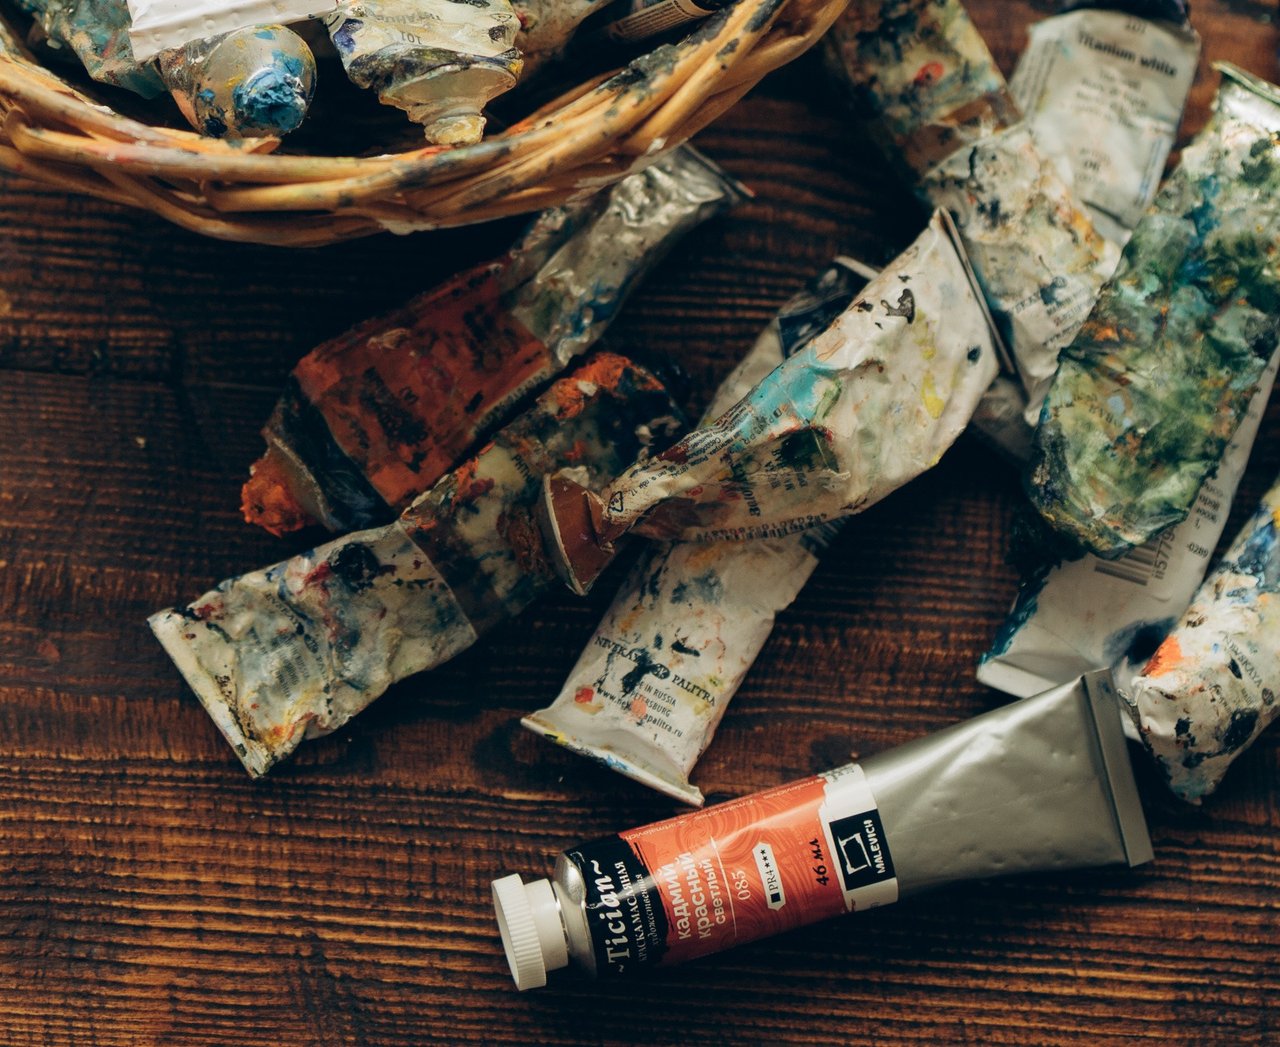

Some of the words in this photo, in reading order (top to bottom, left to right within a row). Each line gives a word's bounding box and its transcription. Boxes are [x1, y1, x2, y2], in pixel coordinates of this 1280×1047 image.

[1140, 54, 1177, 76] white
[594, 636, 646, 666] NEVSKAY
[671, 674, 716, 707] PALITRA
[644, 683, 652, 693] IN
[653, 688, 677, 707] RUSSIA
[596, 687, 683, 737] www.nevapalitra.ru
[629, 691, 672, 718] PETERSBURG
[808, 837, 823, 862] мл
[863, 818, 886, 874] MALEVICH
[616, 860, 643, 925] МАСЛЯНАЯ
[659, 862, 692, 940] кадмий
[675, 851, 713, 939] красный
[700, 858, 726, 924] светлый
[731, 869, 751, 901] 085
[812, 863, 830, 887] 46
[595, 873, 630, 964] Tician
[636, 872, 659, 947] художественная
[631, 921, 649, 962] КРАСКА
